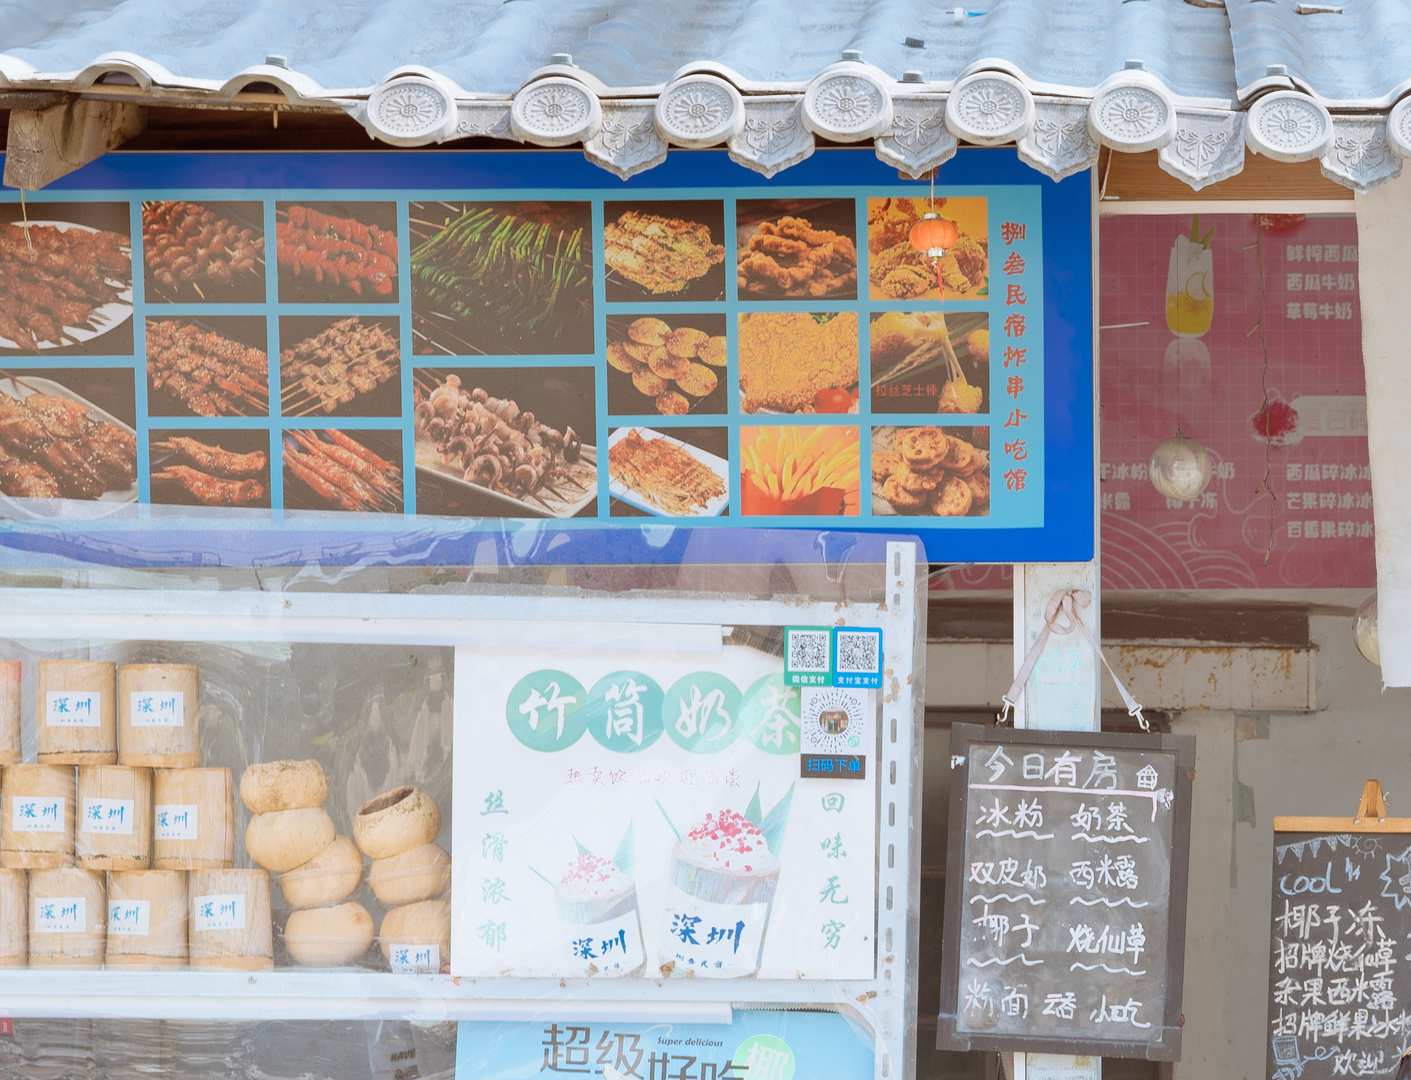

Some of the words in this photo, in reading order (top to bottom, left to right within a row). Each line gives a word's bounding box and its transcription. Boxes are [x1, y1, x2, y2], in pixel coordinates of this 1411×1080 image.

[1286, 273, 1355, 291] 西瓜牛奶
[1001, 221, 1028, 492] 捌叁民宿炸串小吃馆
[518, 679, 801, 748] 竹筒奶茶
[807, 758, 862, 773] 扫码下单
[985, 745, 1118, 789] 今日有房
[976, 798, 1045, 828] 冰粉
[1071, 802, 1134, 833] 奶茶
[819, 792, 848, 950] 回味无穷
[969, 857, 1047, 889] 双皮奶
[1069, 855, 1139, 889] 西米露
[671, 914, 745, 954] 深圳
[1275, 900, 1384, 946] 椰子冻
[572, 929, 626, 960] 深圳
[1067, 923, 1146, 964] 烧仙草
[1274, 938, 1397, 976] 招牌烧仙草
[1275, 971, 1397, 1010] 杂果西米露
[1090, 995, 1151, 1028] 小吃
